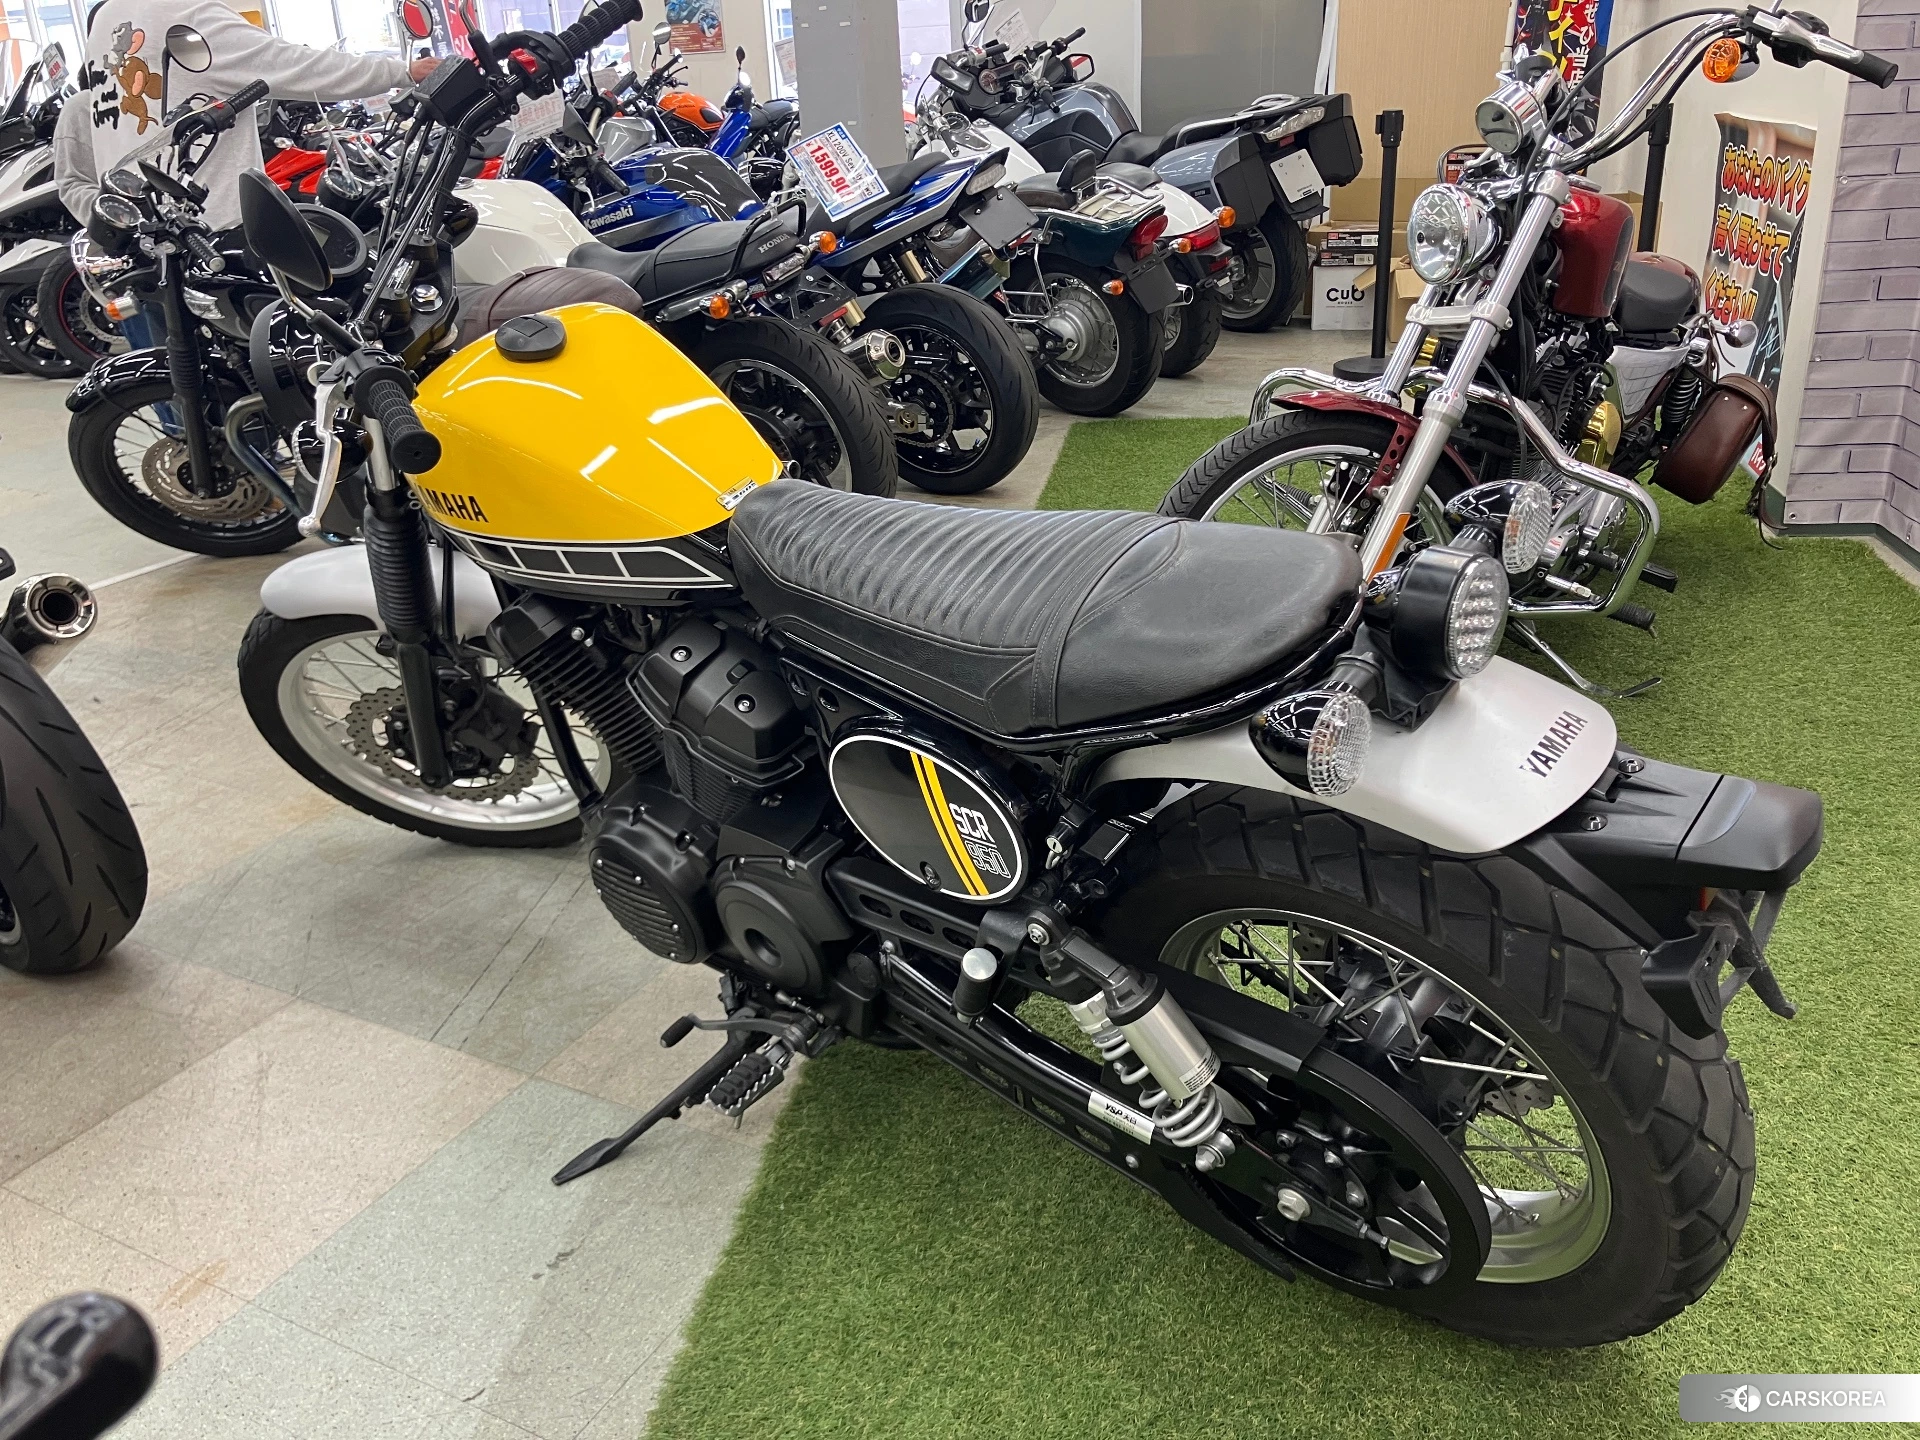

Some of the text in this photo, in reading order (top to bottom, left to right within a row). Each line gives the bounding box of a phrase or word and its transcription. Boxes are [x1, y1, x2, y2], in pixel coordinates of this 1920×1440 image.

[1721, 143, 1812, 217] あなたのバイク
[584, 205, 634, 230] Kawasaki
[758, 233, 791, 254] HONDA
[1712, 203, 1791, 283] 高く買わせて
[1326, 284, 1365, 302] Cub
[1518, 710, 1588, 778] YAMAHA
[949, 803, 996, 844] SCR
[964, 840, 1012, 879] 950
[1105, 1103, 1123, 1116] YSP
